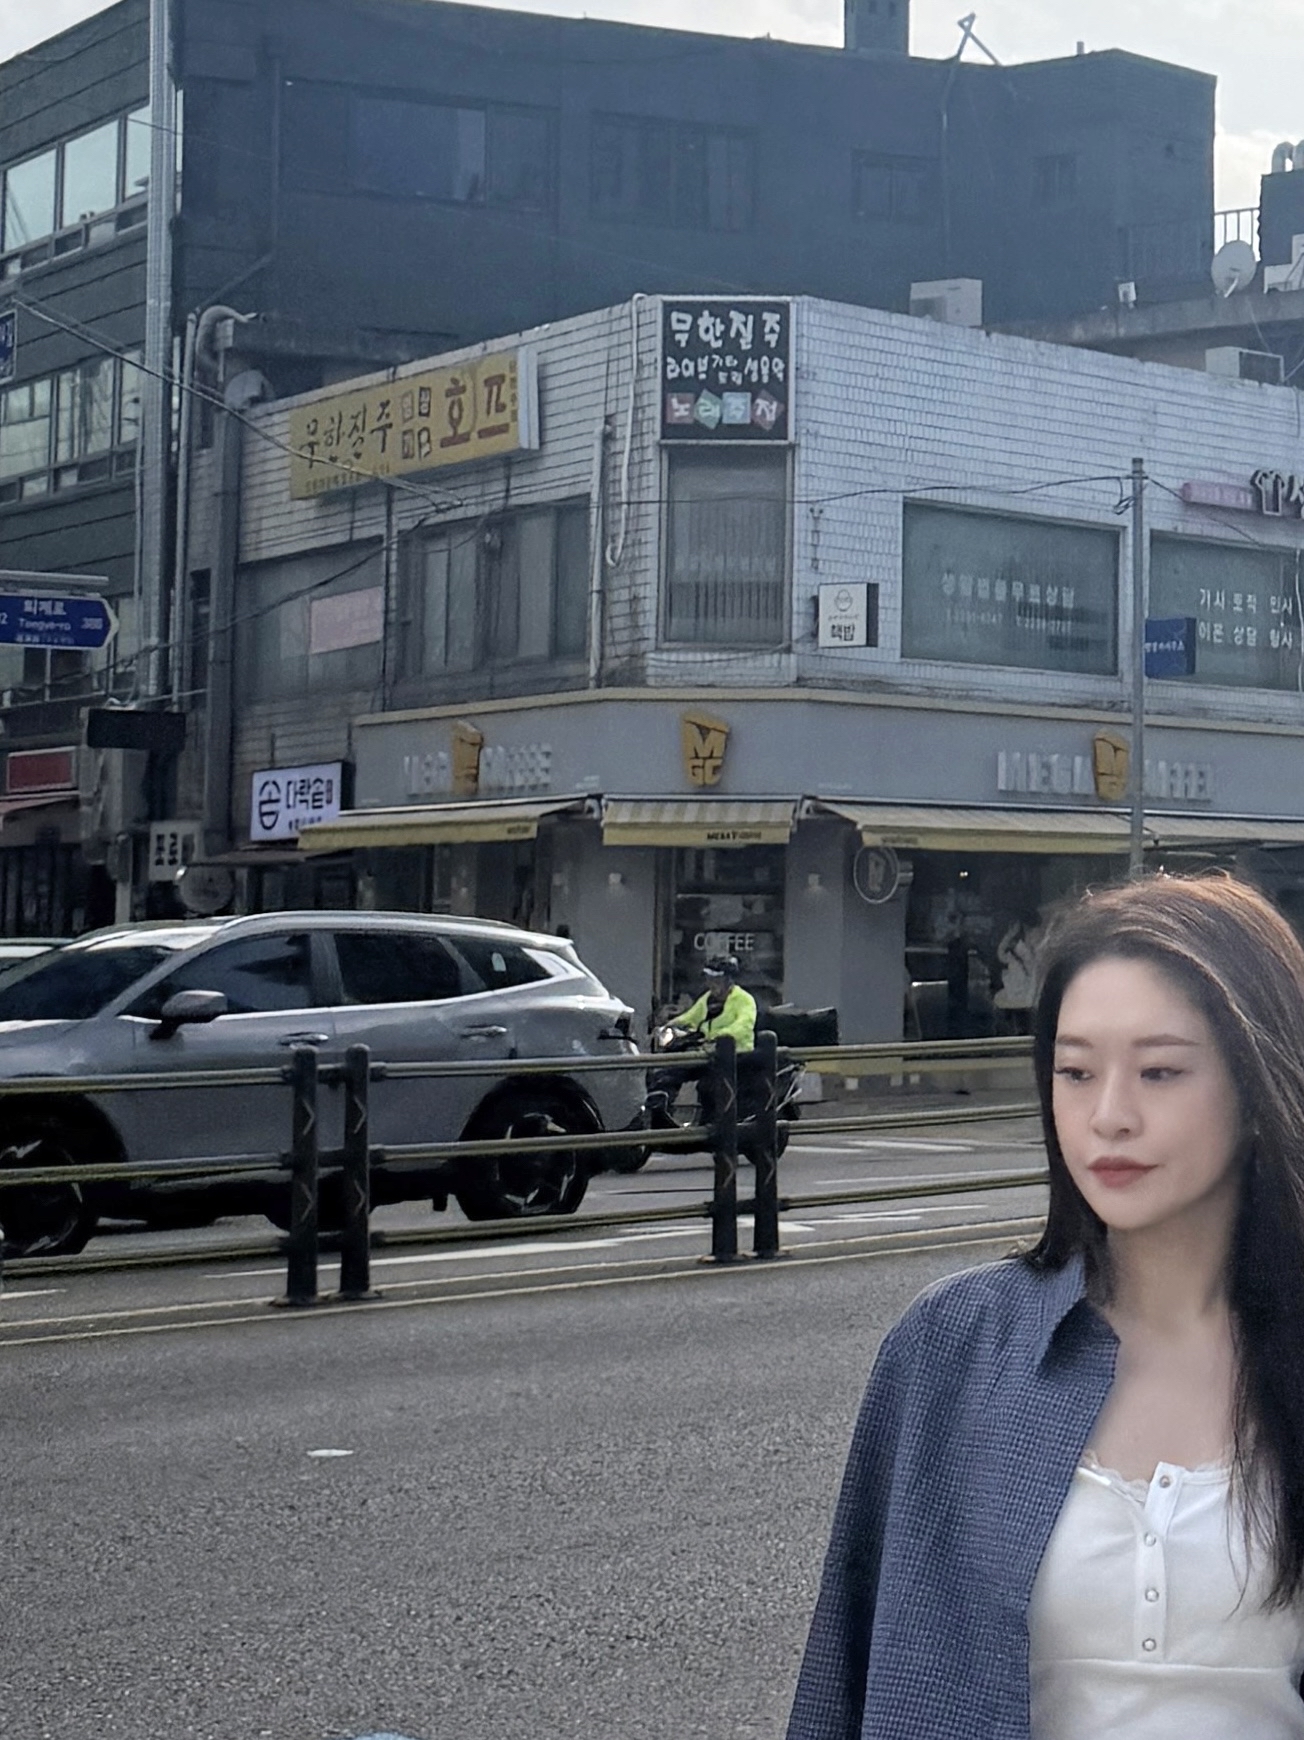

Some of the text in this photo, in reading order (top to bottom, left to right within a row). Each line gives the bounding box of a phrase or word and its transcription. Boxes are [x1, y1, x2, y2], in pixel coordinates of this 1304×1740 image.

[671, 310, 780, 350] 무한질주
[440, 373, 510, 448] 호프
[694, 932, 755, 951] COFEE
